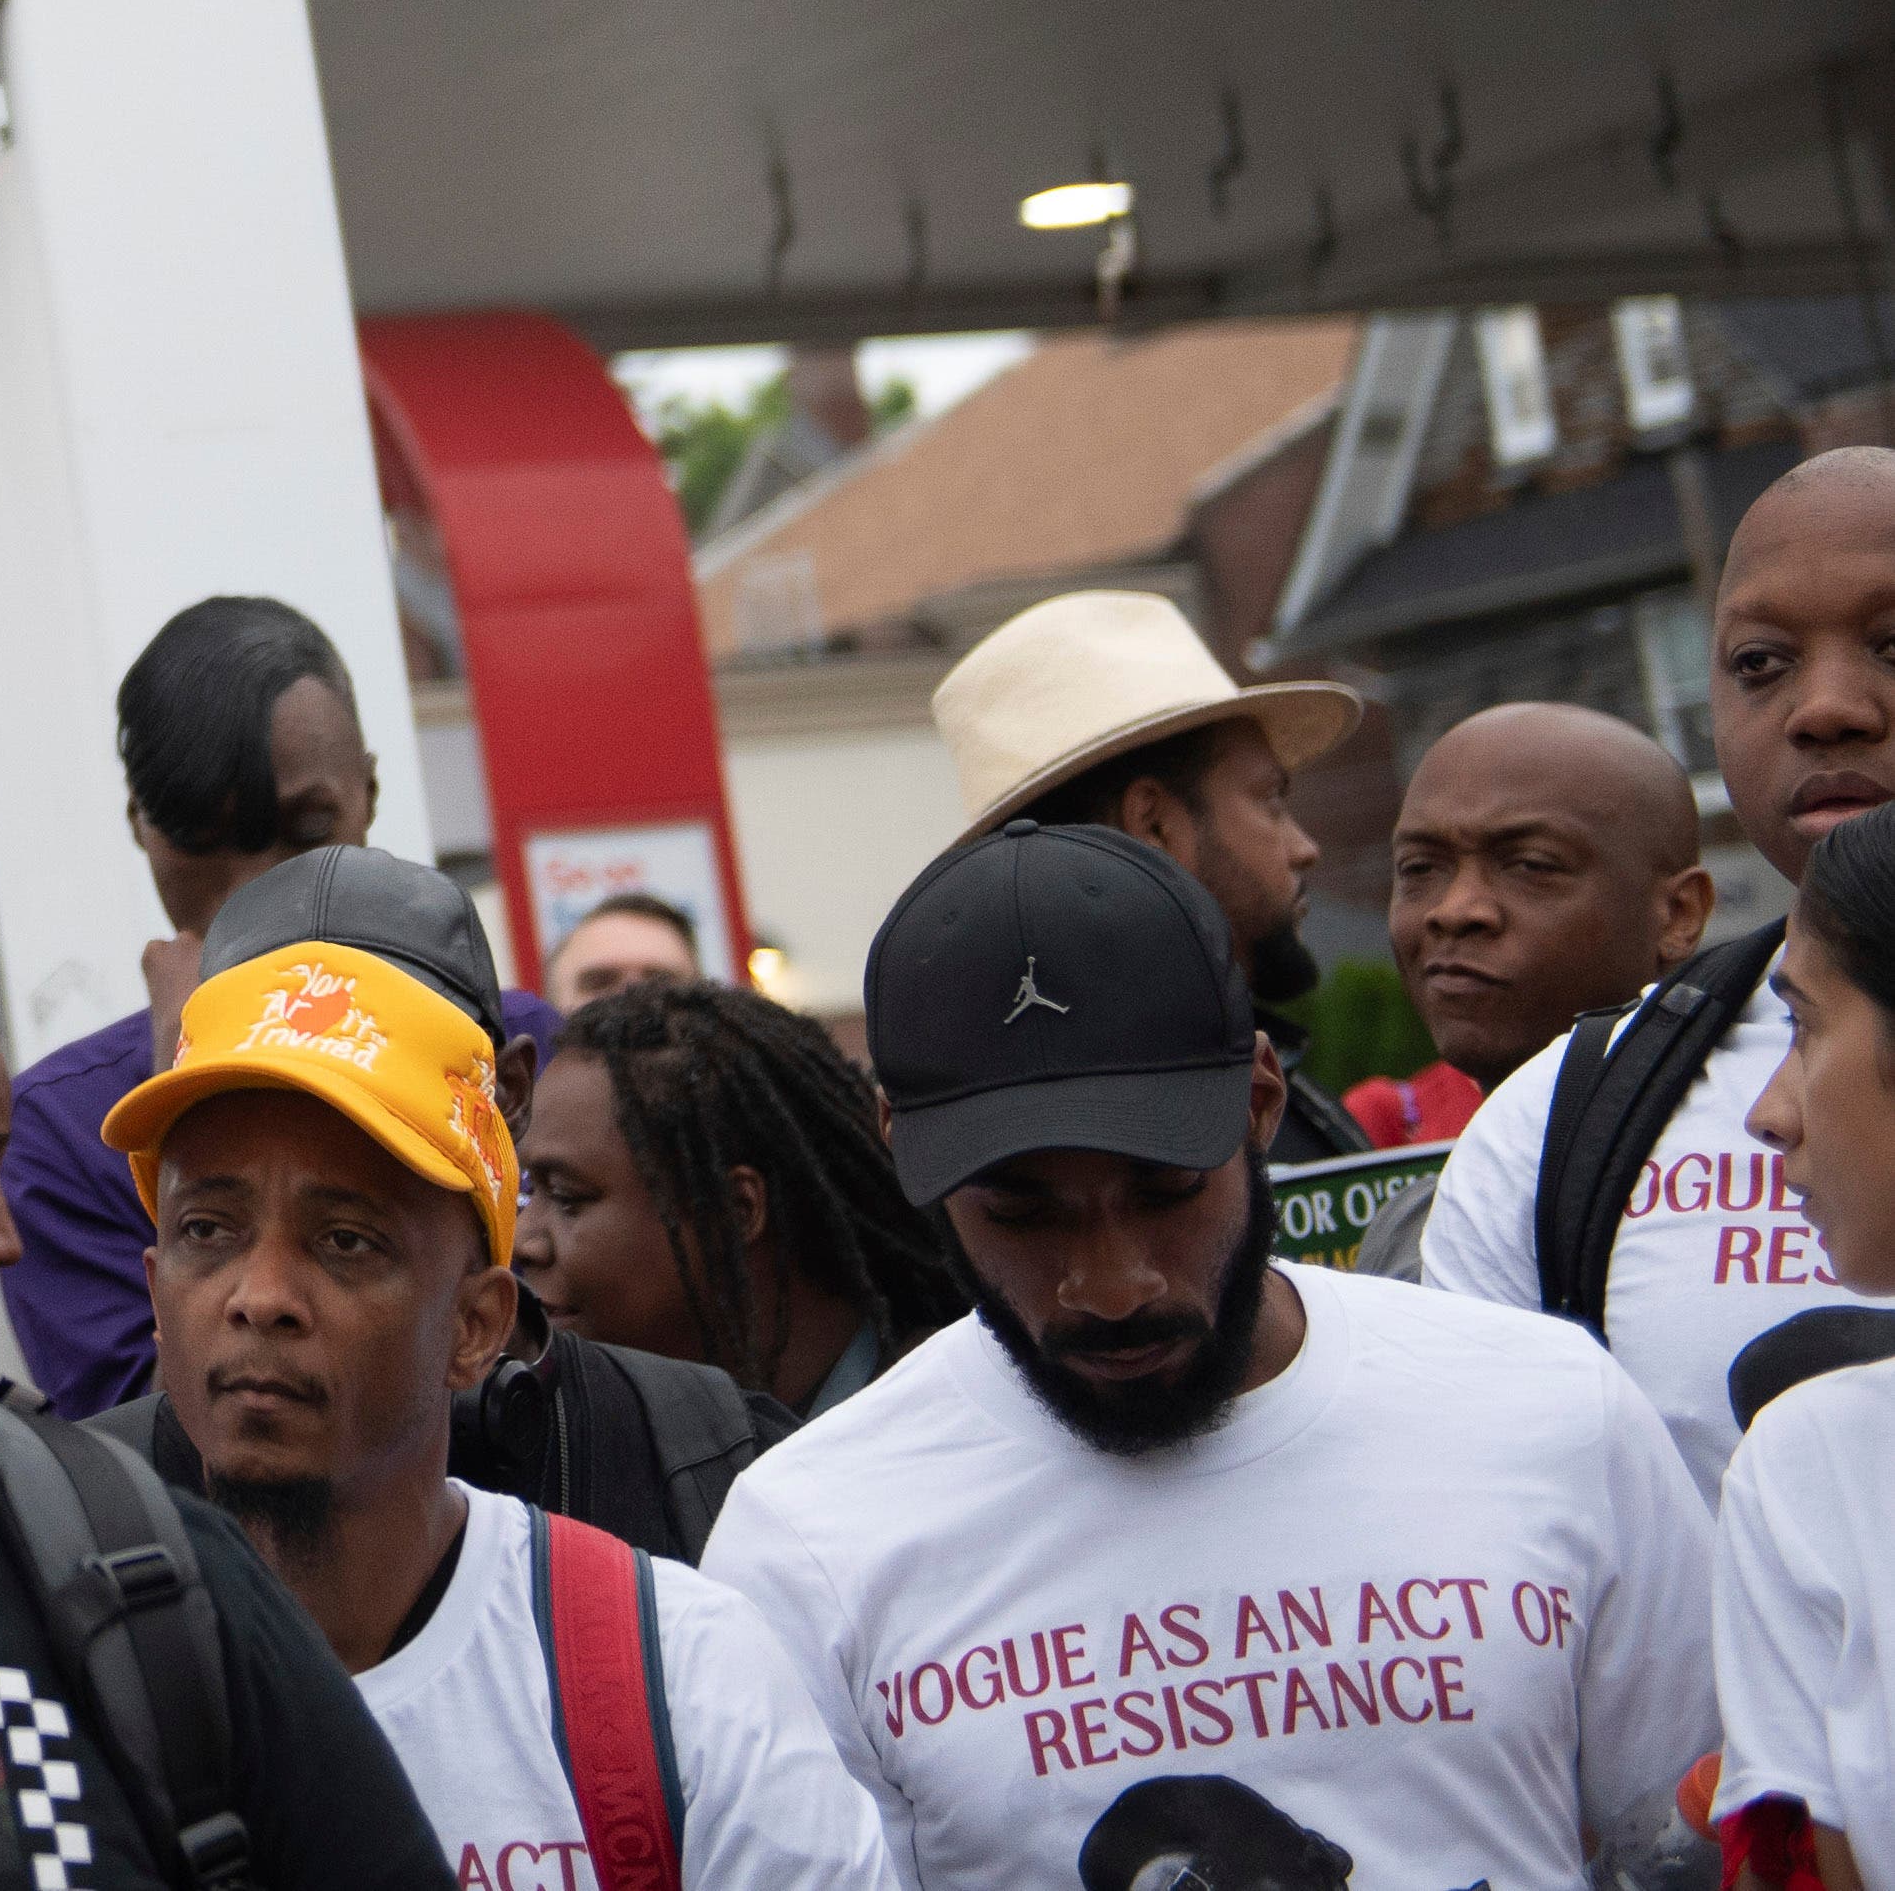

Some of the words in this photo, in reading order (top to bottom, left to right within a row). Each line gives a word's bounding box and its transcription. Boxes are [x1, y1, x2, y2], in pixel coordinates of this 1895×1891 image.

[1274, 1190, 1338, 1242] OR
[875, 1623, 1097, 1740] VOGUE
[1117, 1603, 1211, 1679] AS
[1233, 1586, 1334, 1660] AN
[1357, 1577, 1489, 1645] ACT
[1510, 1580, 1574, 1650] OF
[1023, 1655, 1475, 1776] RESISTANCE
[457, 1840, 588, 1891] ACT
